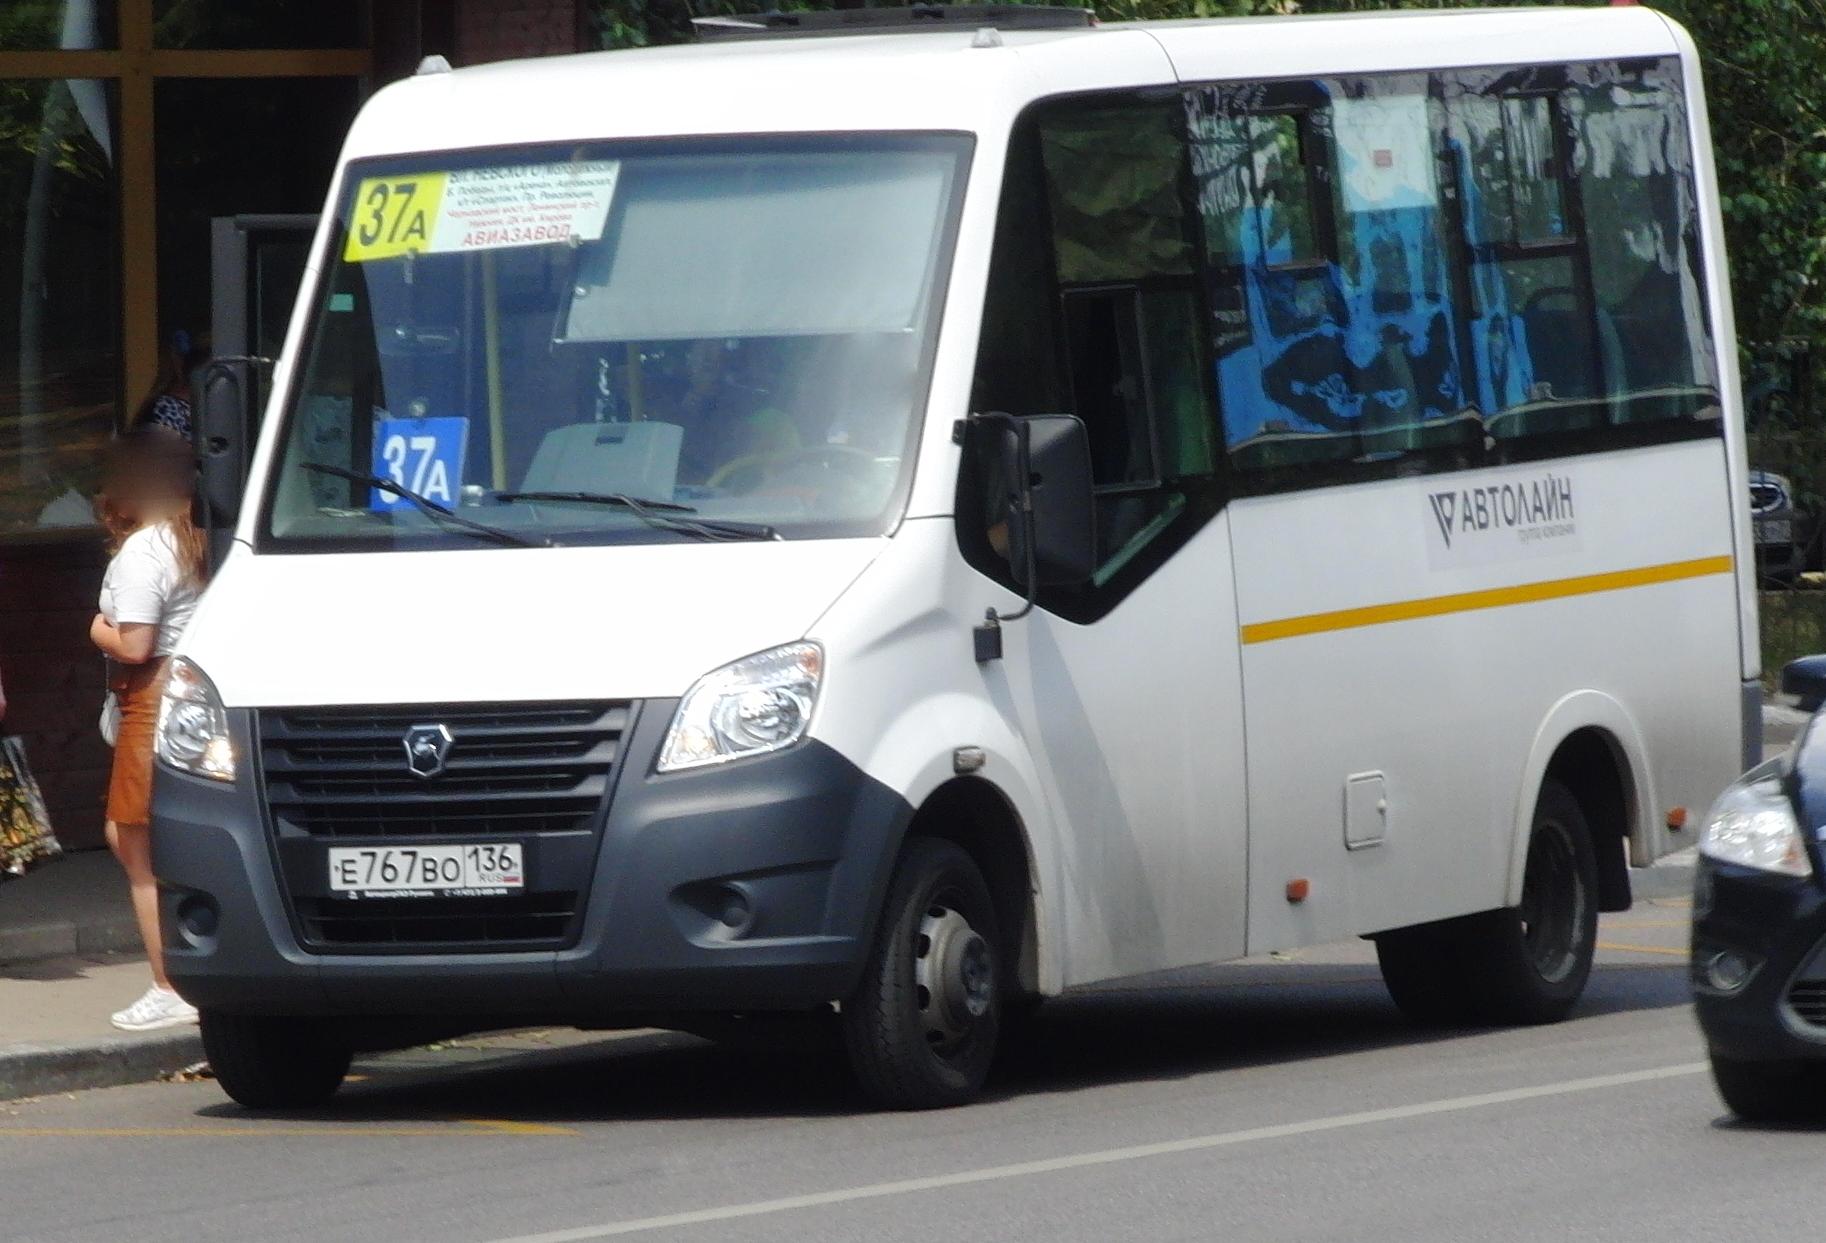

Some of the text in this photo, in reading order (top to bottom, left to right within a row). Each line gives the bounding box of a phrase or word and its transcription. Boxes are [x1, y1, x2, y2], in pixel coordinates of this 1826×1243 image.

[359, 183, 426, 246] 37А
[464, 223, 571, 246] АВИАЗАВОД
[379, 434, 451, 504] 37А
[1462, 473, 1575, 532] АВТОЛАЙН
[340, 846, 513, 885] Е767ВО 136
